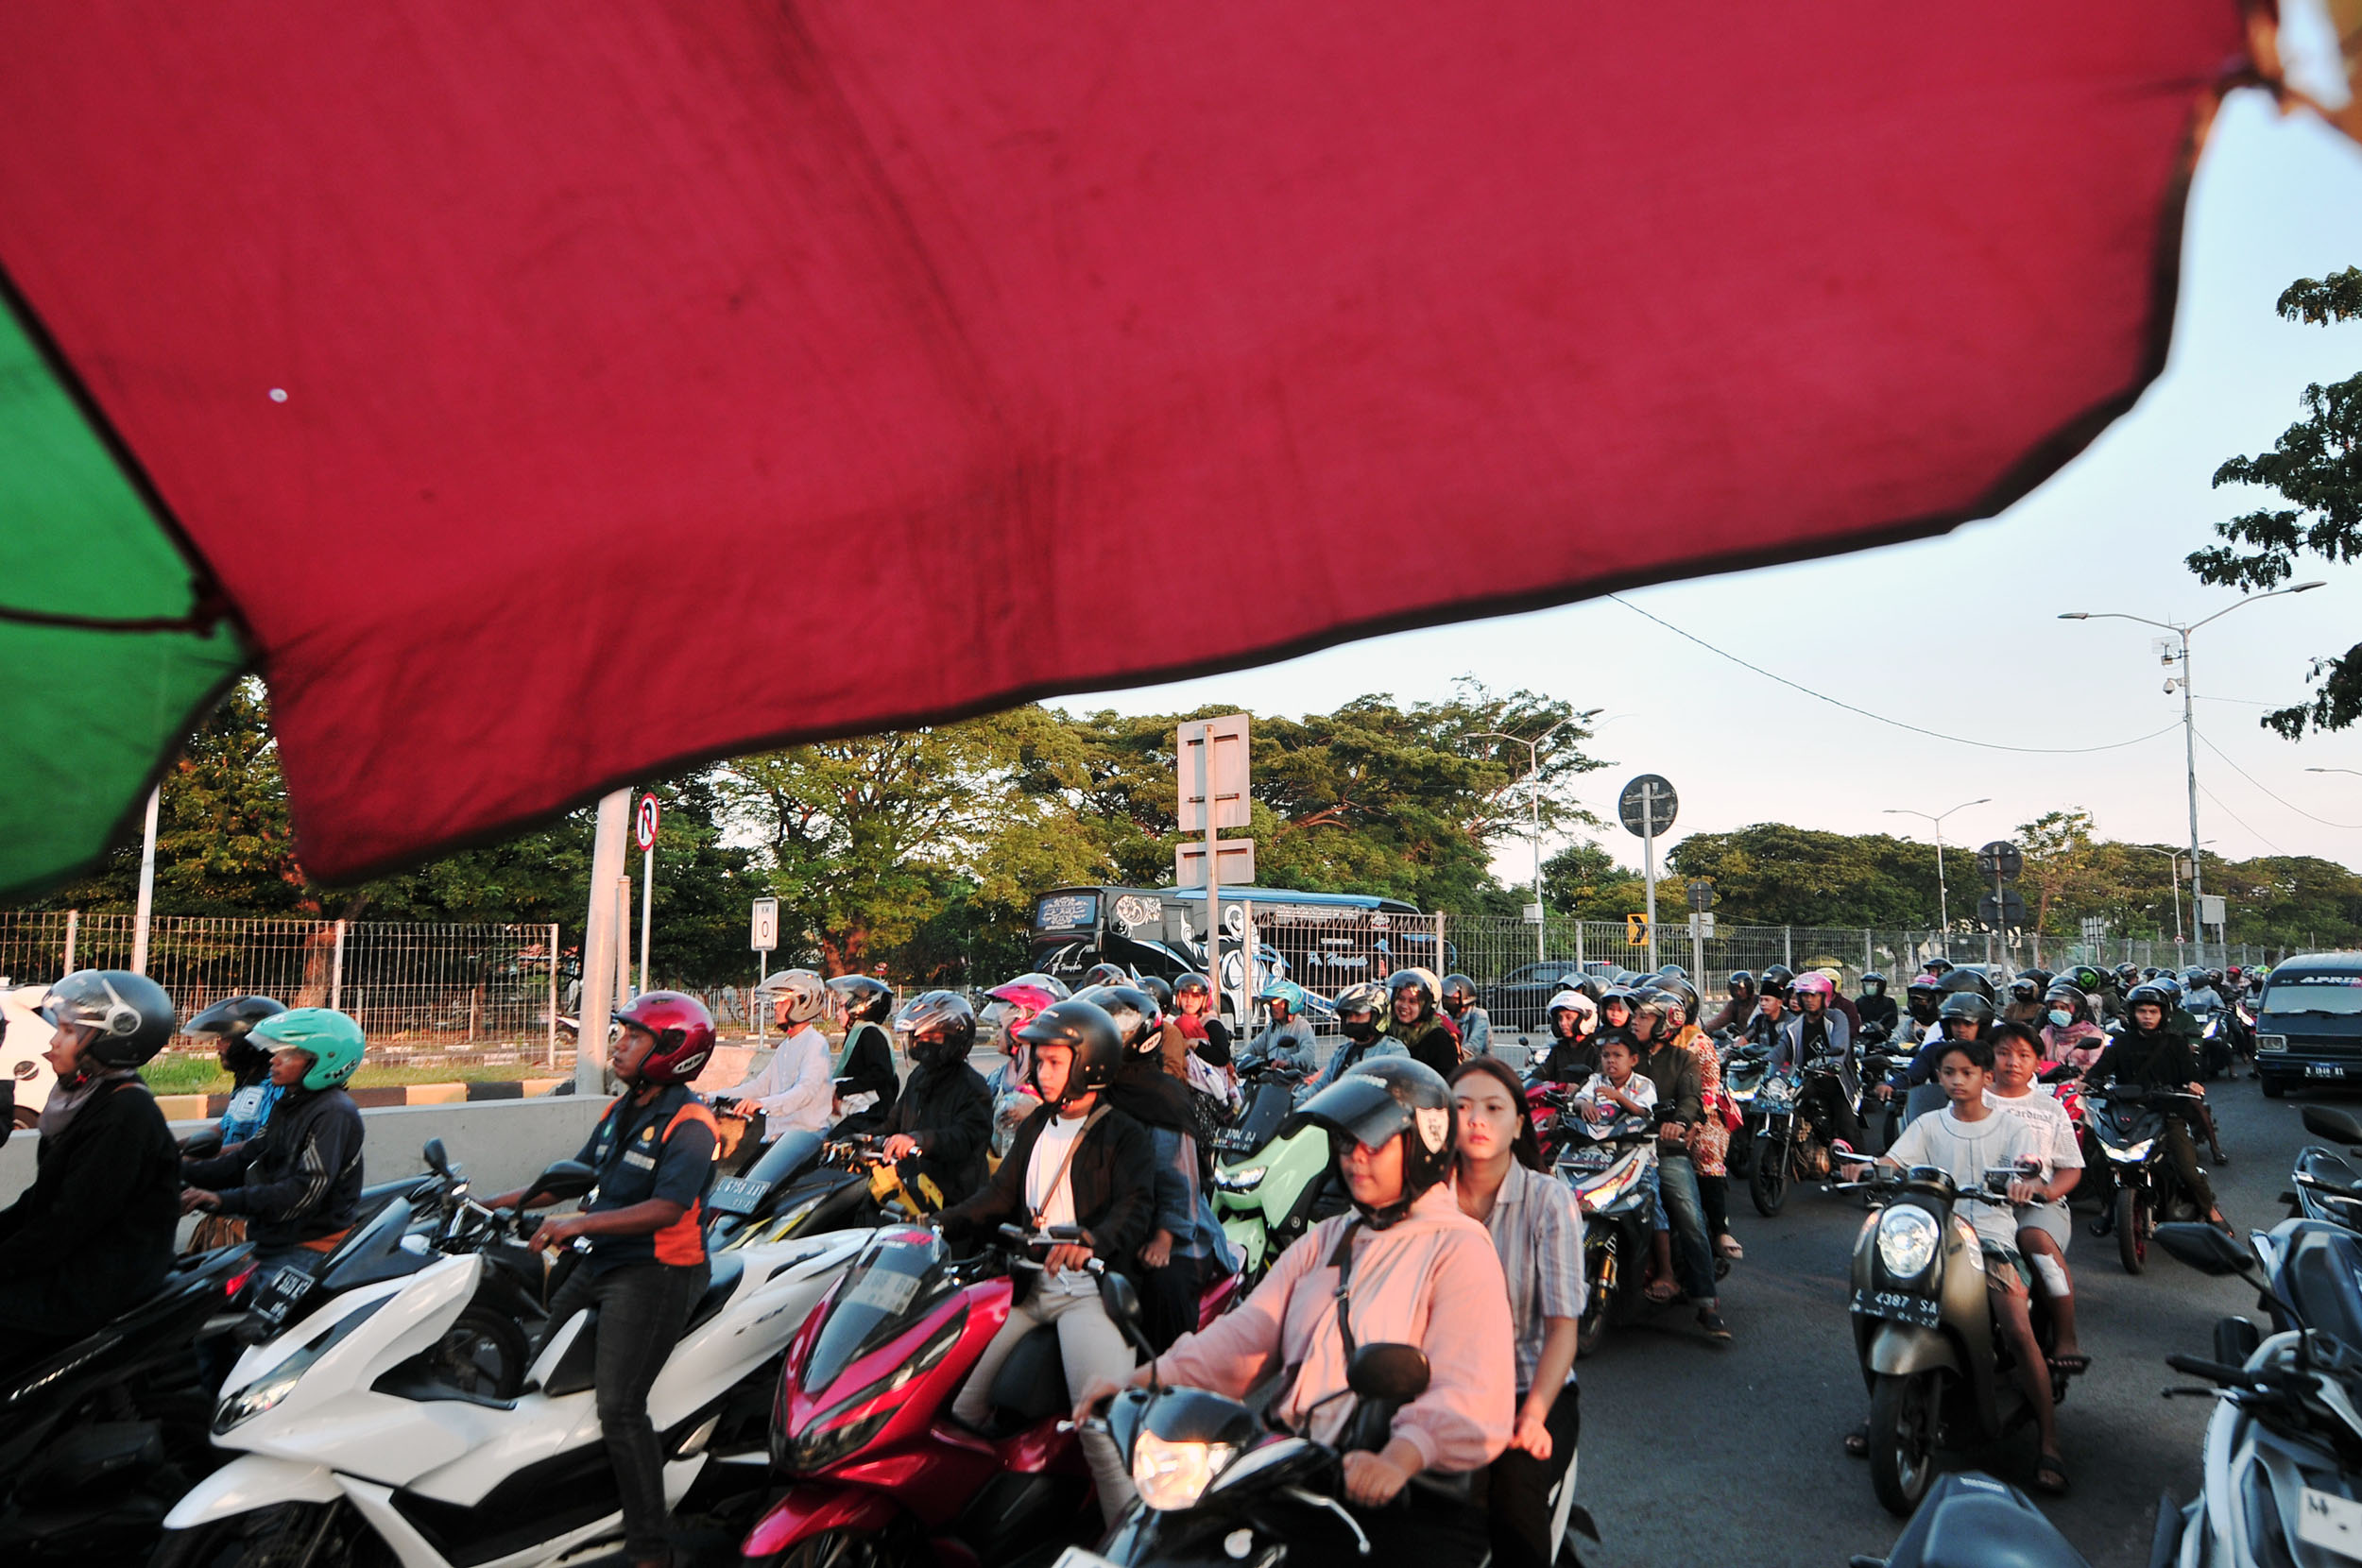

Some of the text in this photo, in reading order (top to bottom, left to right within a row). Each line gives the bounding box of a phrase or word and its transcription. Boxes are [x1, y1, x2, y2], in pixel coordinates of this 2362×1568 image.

[762, 921, 769, 937] 0
[1856, 1287, 1863, 1301] L
[1919, 1299, 1938, 1315] SA
